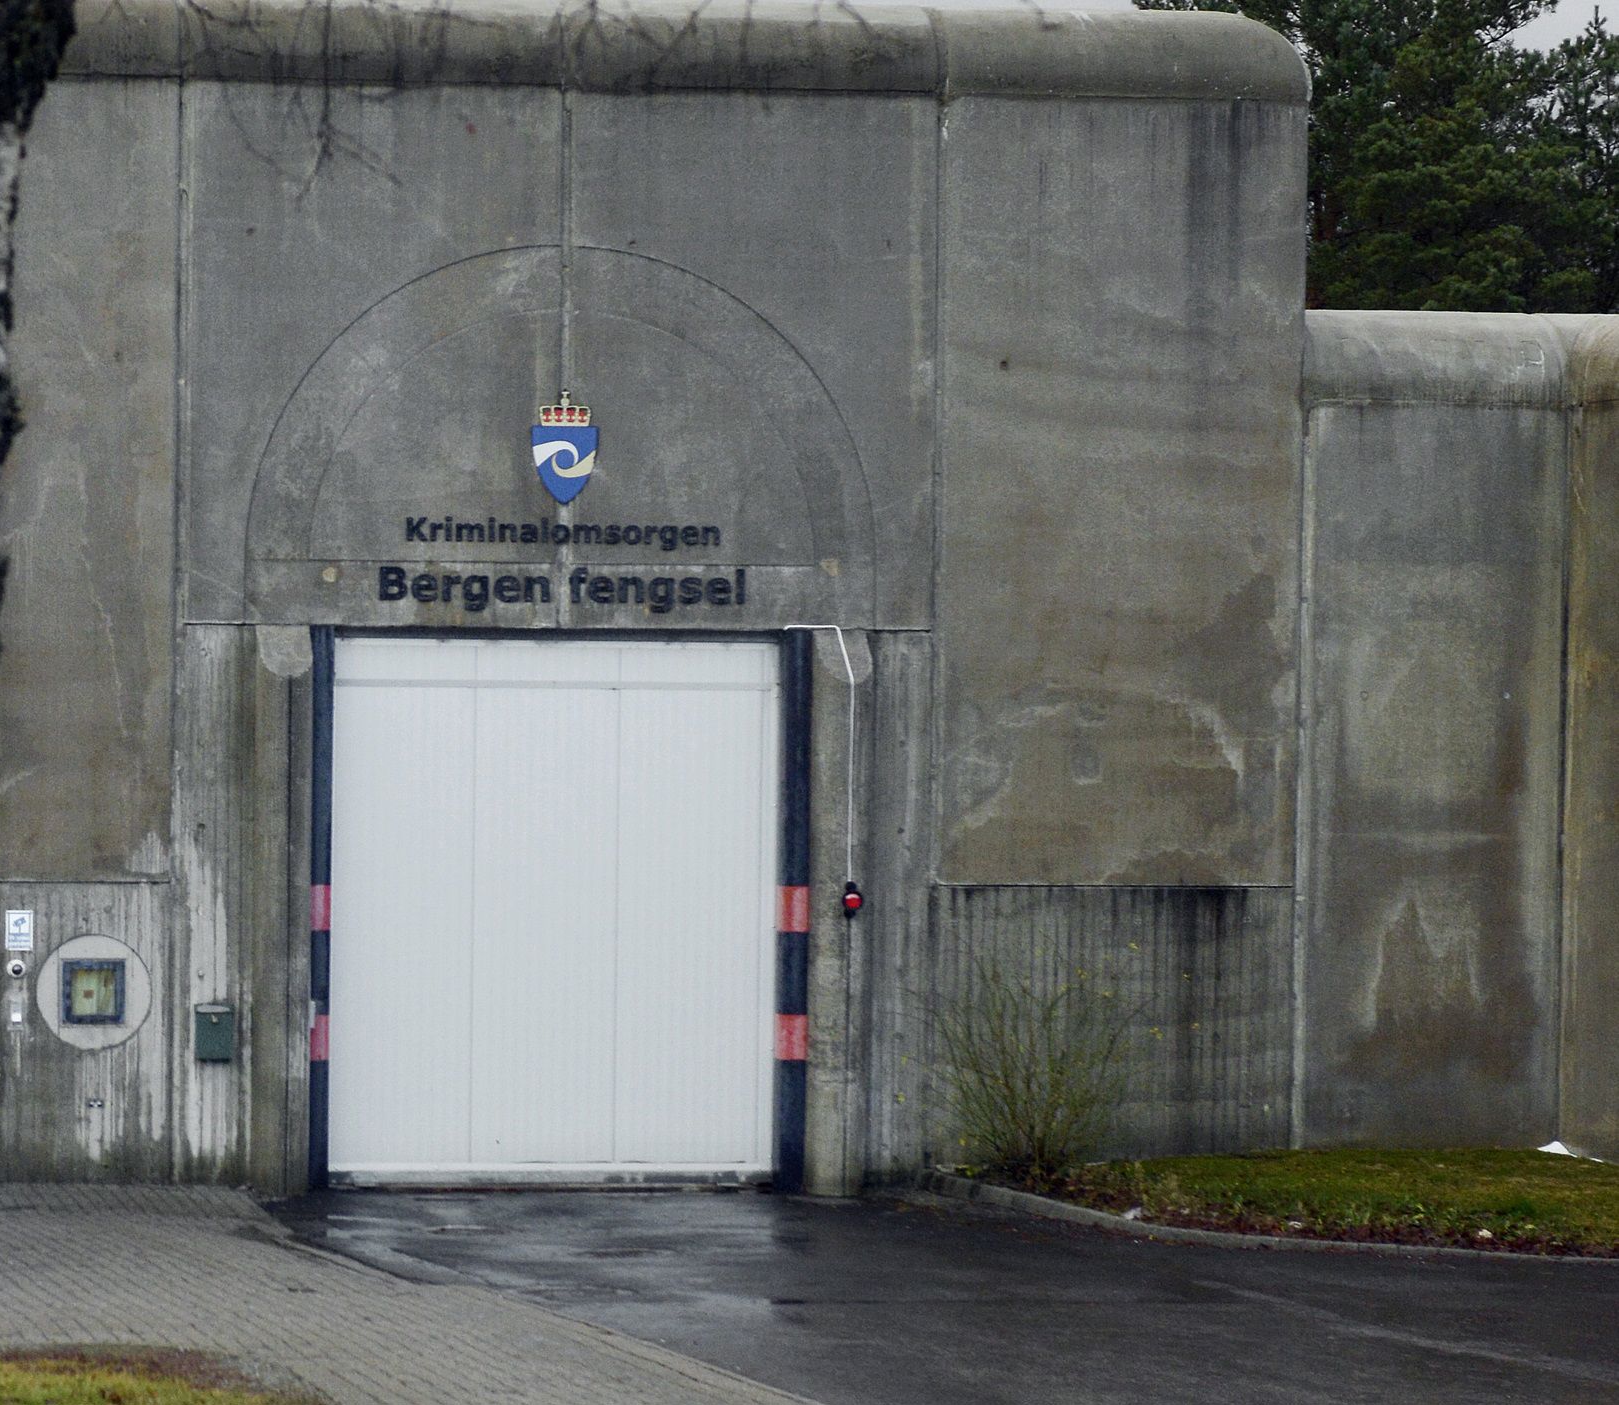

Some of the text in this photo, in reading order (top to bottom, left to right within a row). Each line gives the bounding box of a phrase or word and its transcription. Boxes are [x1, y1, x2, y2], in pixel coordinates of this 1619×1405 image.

[405, 516, 721, 550] Kriminalomsorgen
[378, 566, 746, 613] Bergen fengsel
